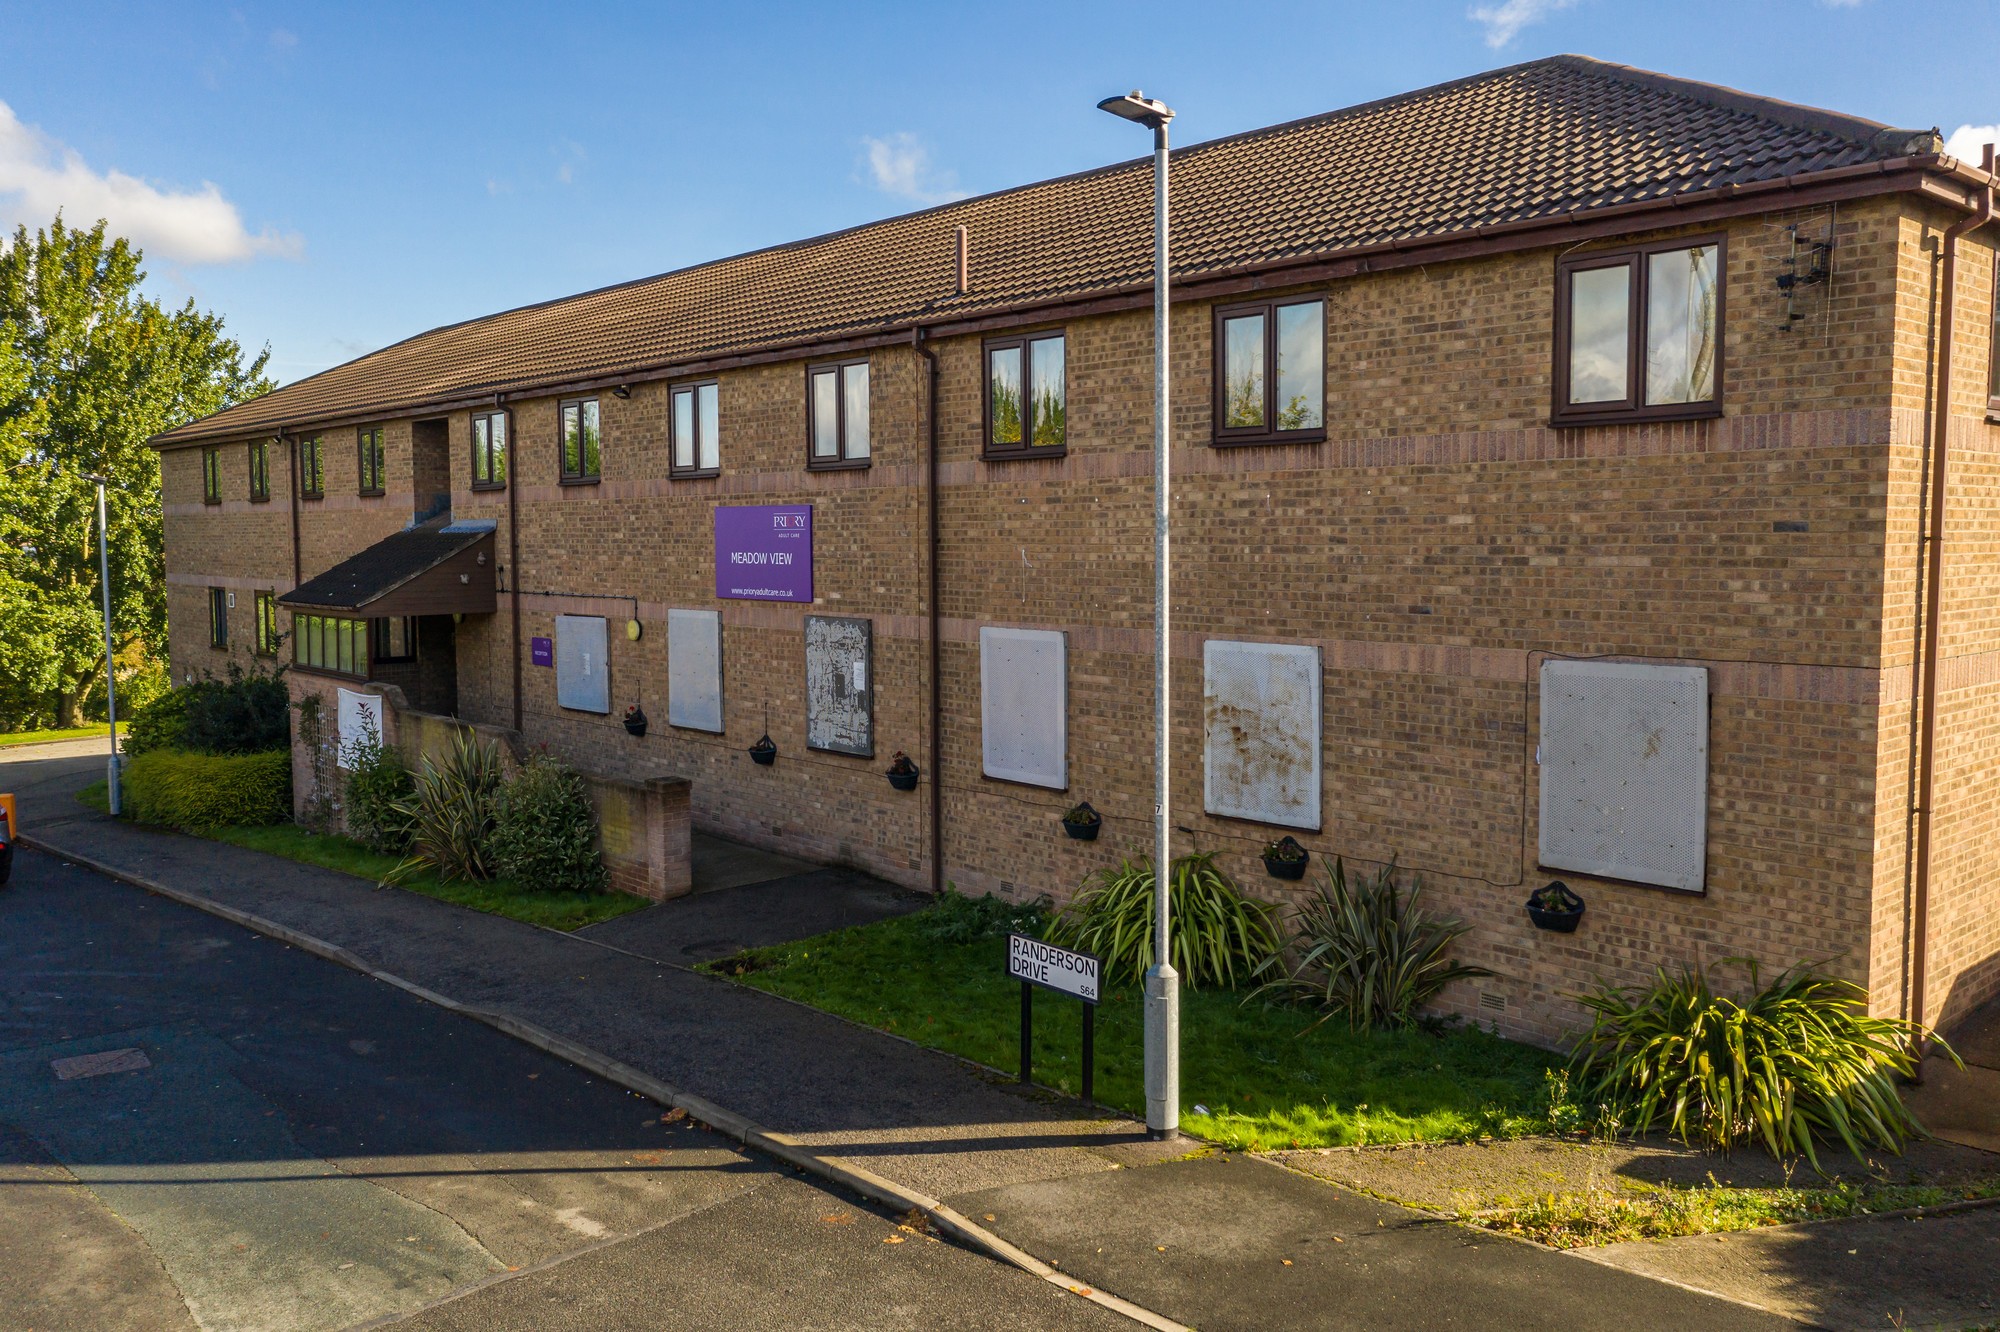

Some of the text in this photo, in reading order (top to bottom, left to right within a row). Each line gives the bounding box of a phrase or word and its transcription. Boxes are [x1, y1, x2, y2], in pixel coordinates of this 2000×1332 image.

[773, 515, 806, 528] PRIORY
[731, 552, 793, 565] MEADOW VIEW
[731, 588, 794, 597] www.prioryadultcare.co.uk
[1156, 805, 1160, 813] 7
[1013, 938, 1095, 978] RANDERSON
[1013, 957, 1049, 982] DRIVE
[1080, 985, 1095, 997] S64
